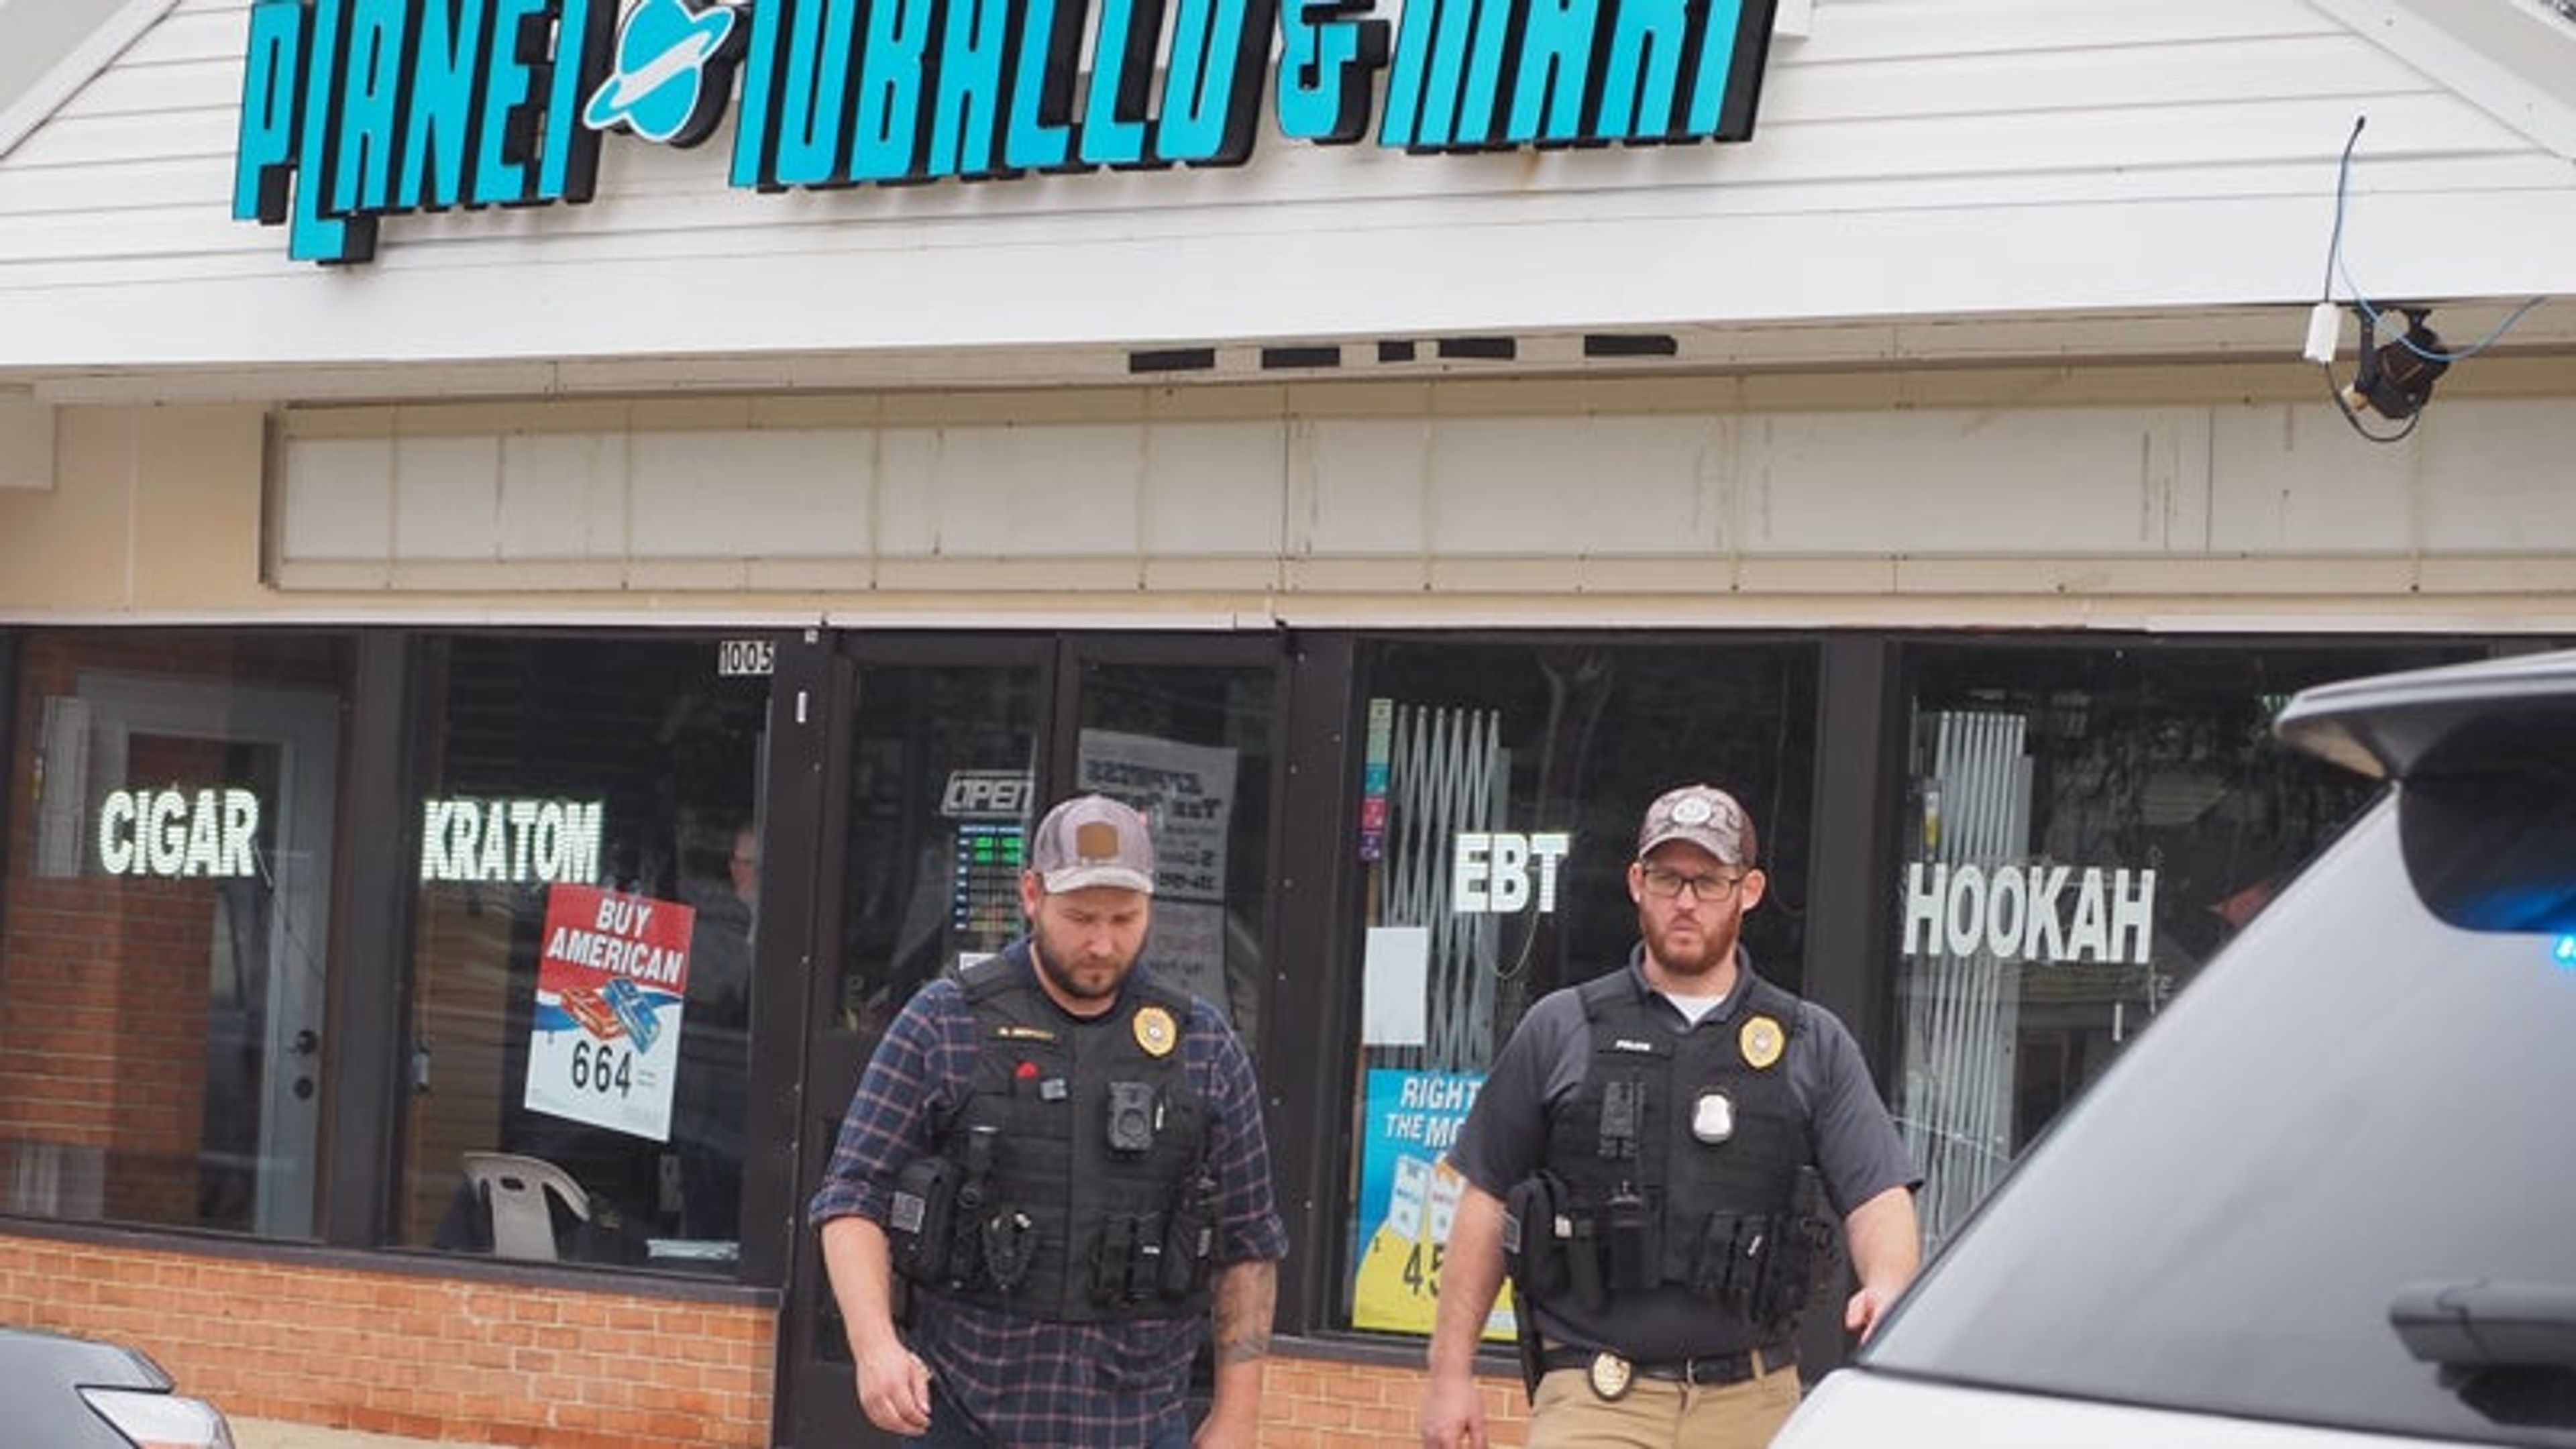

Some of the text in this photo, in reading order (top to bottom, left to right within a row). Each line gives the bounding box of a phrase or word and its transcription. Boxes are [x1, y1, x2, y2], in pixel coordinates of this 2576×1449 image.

[1275, 0, 1368, 140] &
[720, 643, 773, 672] 1005
[100, 789, 259, 876] CIGAR
[421, 801, 603, 883] KRATOM
[1454, 832, 1570, 913] EBT
[596, 898, 651, 938] BUY
[1903, 863, 2155, 964] HOOKAH
[547, 927, 684, 983] AMERICAN
[572, 1040, 633, 1099] 664
[1399, 1077, 1483, 1115] RIGHT
[1386, 1114, 1424, 1138] THE
